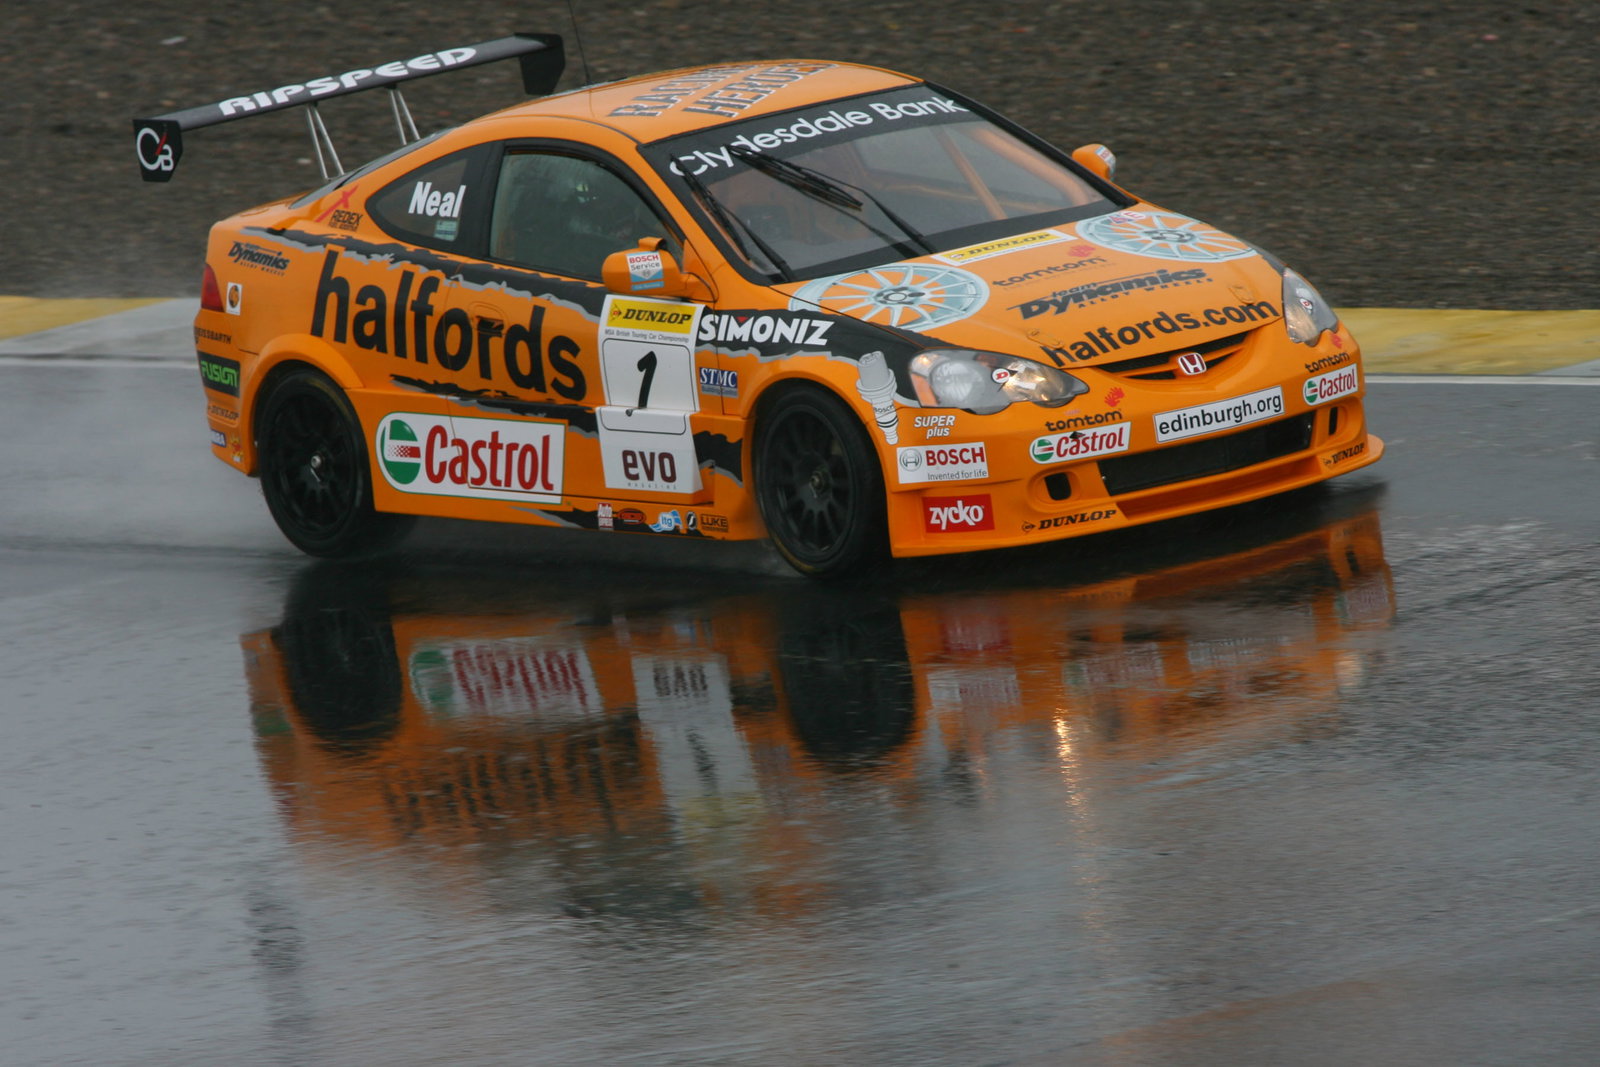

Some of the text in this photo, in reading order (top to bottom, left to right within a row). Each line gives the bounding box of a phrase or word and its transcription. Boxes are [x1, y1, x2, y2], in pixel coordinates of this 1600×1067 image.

[217, 47, 477, 116] RIPSPEED
[669, 96, 971, 178] Clydesdale Bank
[408, 181, 467, 218] Neal
[967, 232, 1051, 255] DUNLOP
[227, 243, 291, 273] Dynamics
[628, 253, 660, 264] BOSCH
[630, 261, 660, 272] Service
[992, 256, 1108, 287] tomtom
[1018, 268, 1208, 320] Dynamics
[1052, 282, 1099, 298] team
[1078, 277, 1215, 309] ALLOY WHEELS
[310, 248, 588, 402] halfords
[622, 308, 692, 325] DUNLOP
[698, 313, 836, 347] SIMONIZ
[1040, 299, 1281, 369] halfords.com
[200, 359, 239, 388] FUSION
[1305, 351, 1350, 373] tomtom
[636, 350, 658, 410] 1
[700, 367, 738, 388] STMC
[1318, 371, 1357, 399] Castrol
[914, 415, 956, 429] SUPER
[1045, 410, 1123, 432] tomtom
[1158, 394, 1282, 435] edinburgh.org
[926, 426, 951, 440] plus
[1056, 431, 1124, 458] Castrol
[425, 424, 554, 491] Castrol
[622, 449, 677, 483] evo
[925, 446, 985, 467] BOSCH
[1331, 442, 1366, 465] DUNLOP
[927, 468, 988, 481] Invented for life
[700, 515, 728, 528] LUKE
[929, 499, 985, 531] zycko
[1038, 509, 1117, 531] DUNLOP
